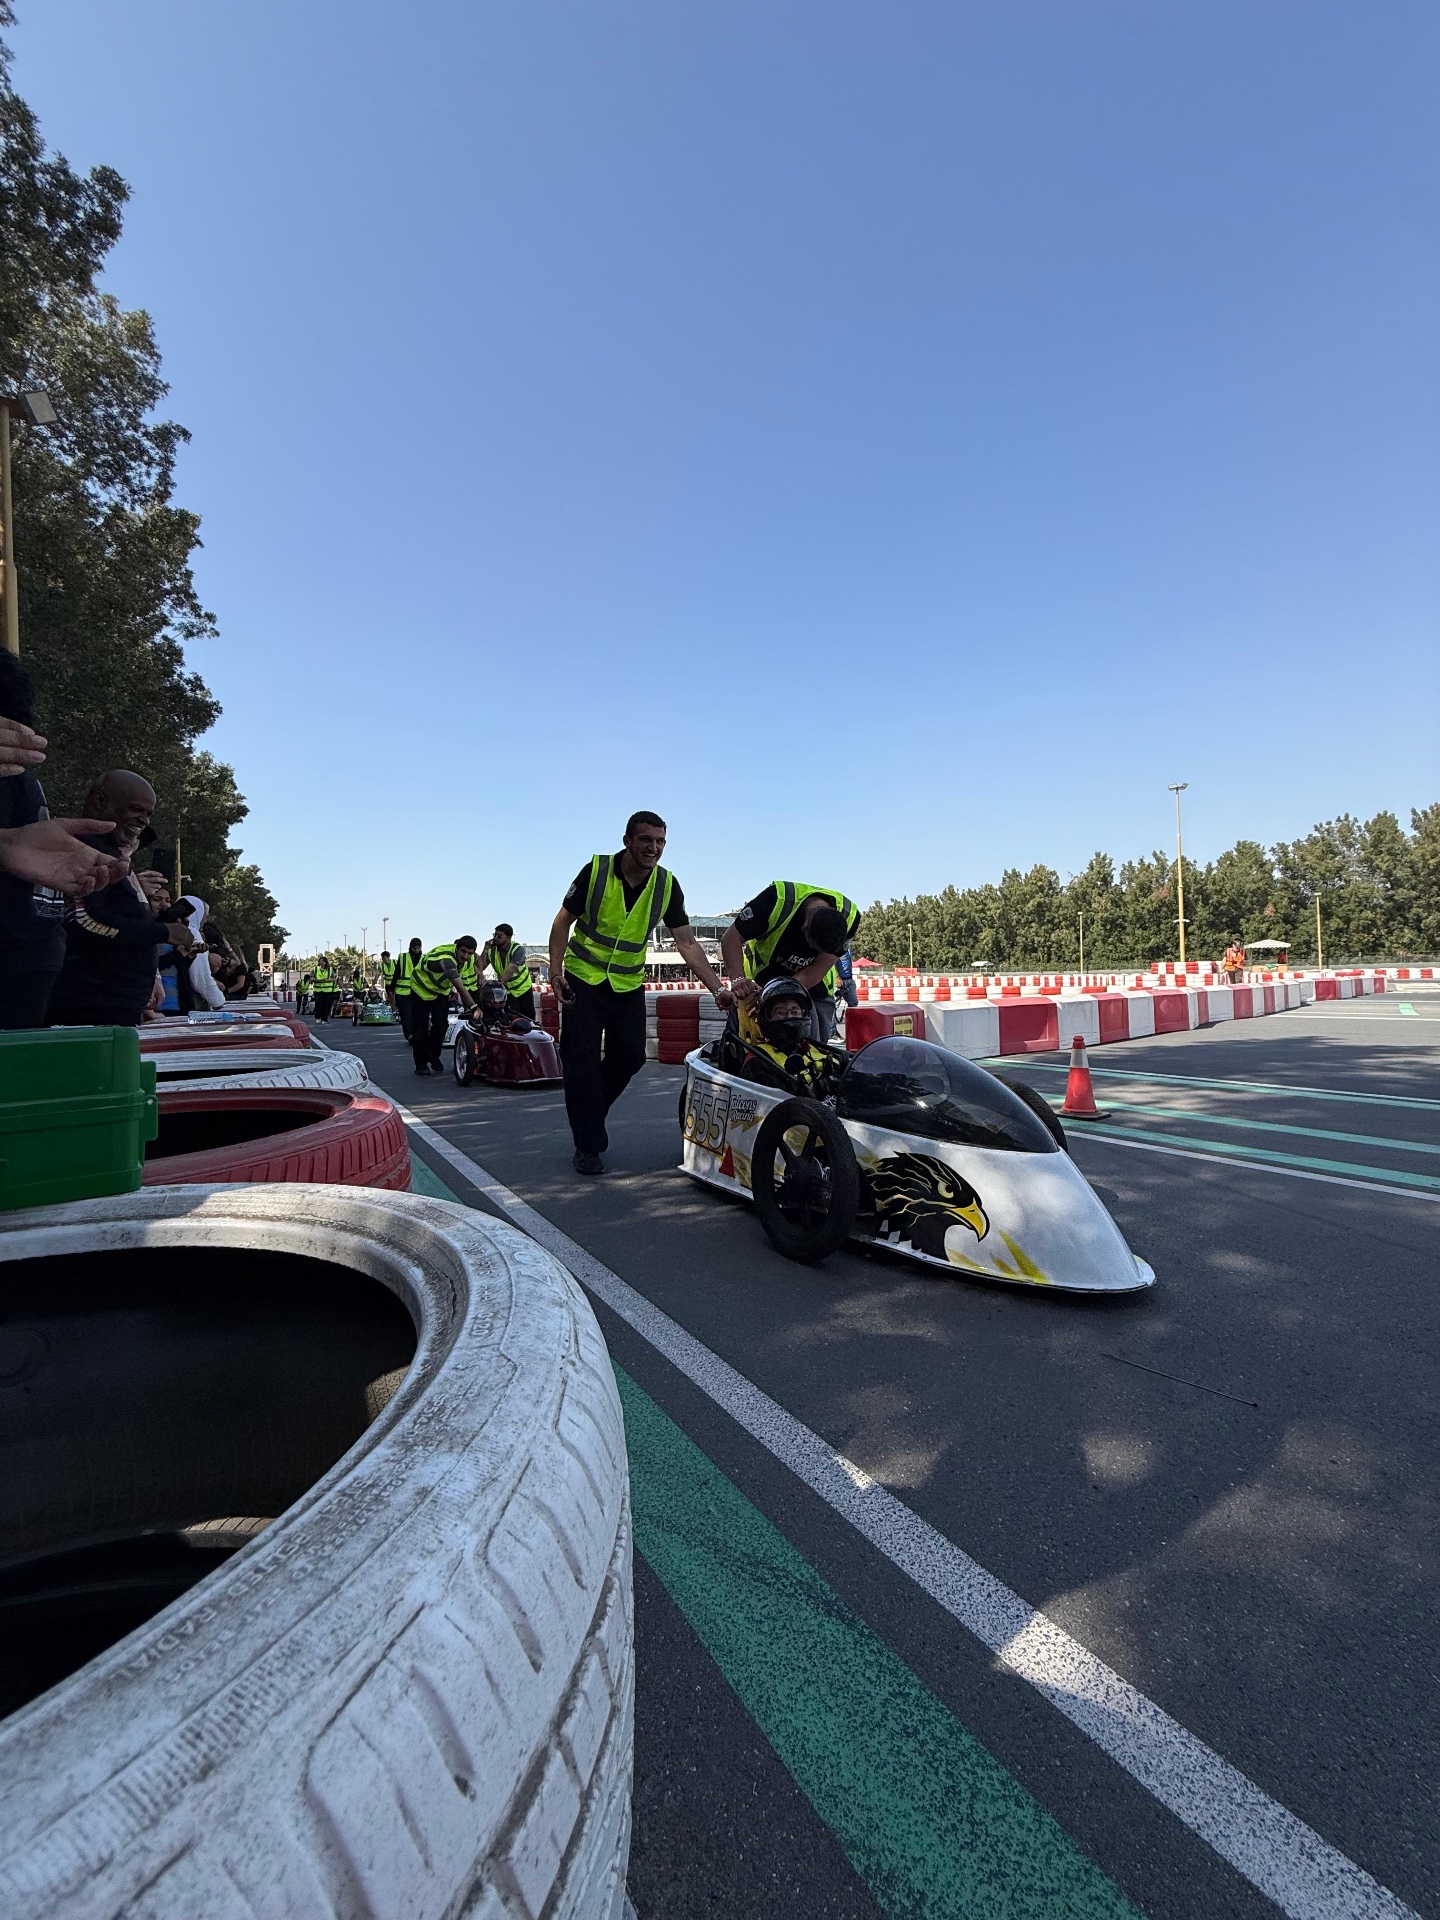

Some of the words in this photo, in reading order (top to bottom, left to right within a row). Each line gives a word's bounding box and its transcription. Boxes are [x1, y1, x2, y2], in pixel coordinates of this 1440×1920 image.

[685, 1090, 728, 1150] 555
[729, 1094, 758, 1112] Falcons
[731, 1109, 756, 1126] Racing
[228, 1530, 311, 1596] BELTED
[117, 1601, 218, 1685] RADIAL
